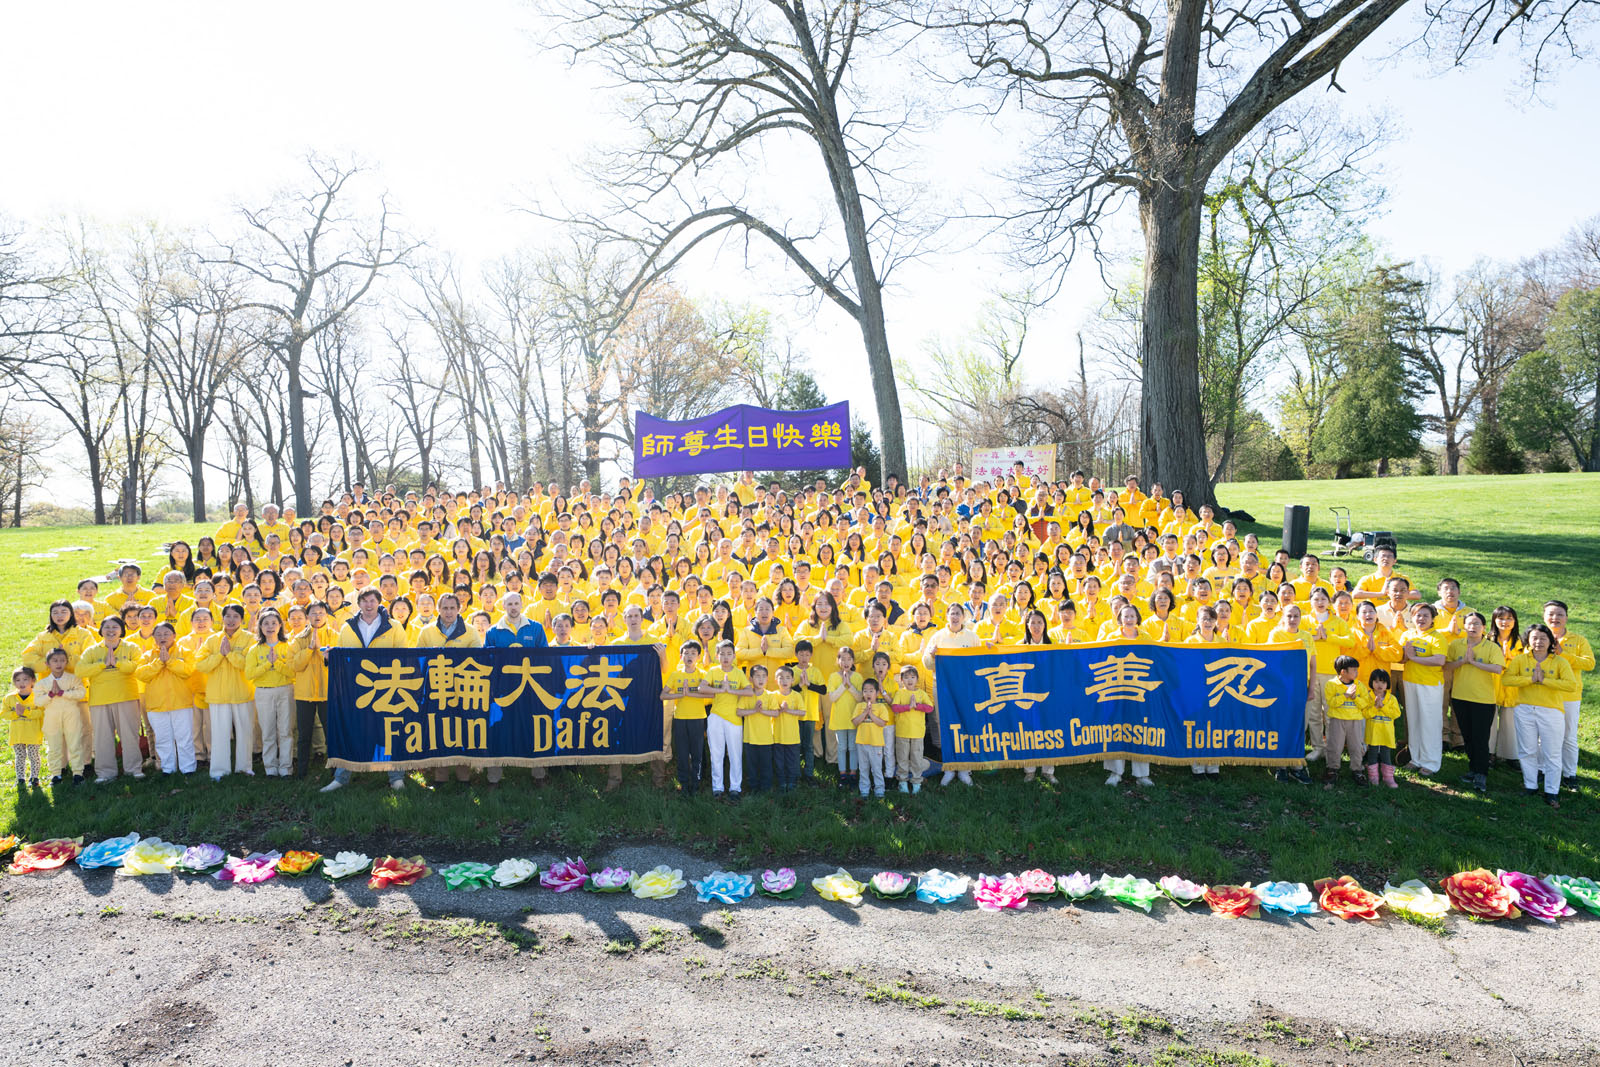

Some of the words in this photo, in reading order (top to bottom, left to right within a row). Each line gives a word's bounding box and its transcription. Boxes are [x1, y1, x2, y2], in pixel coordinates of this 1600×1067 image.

[643, 421, 842, 457] 師尊生日快樂
[355, 654, 633, 714] 法輪大法
[383, 713, 488, 756] Falun
[532, 711, 610, 753] Dafa
[949, 721, 1064, 760] Truthfulness
[1070, 717, 1166, 753] Compassion
[1183, 719, 1278, 751] Tolerance
